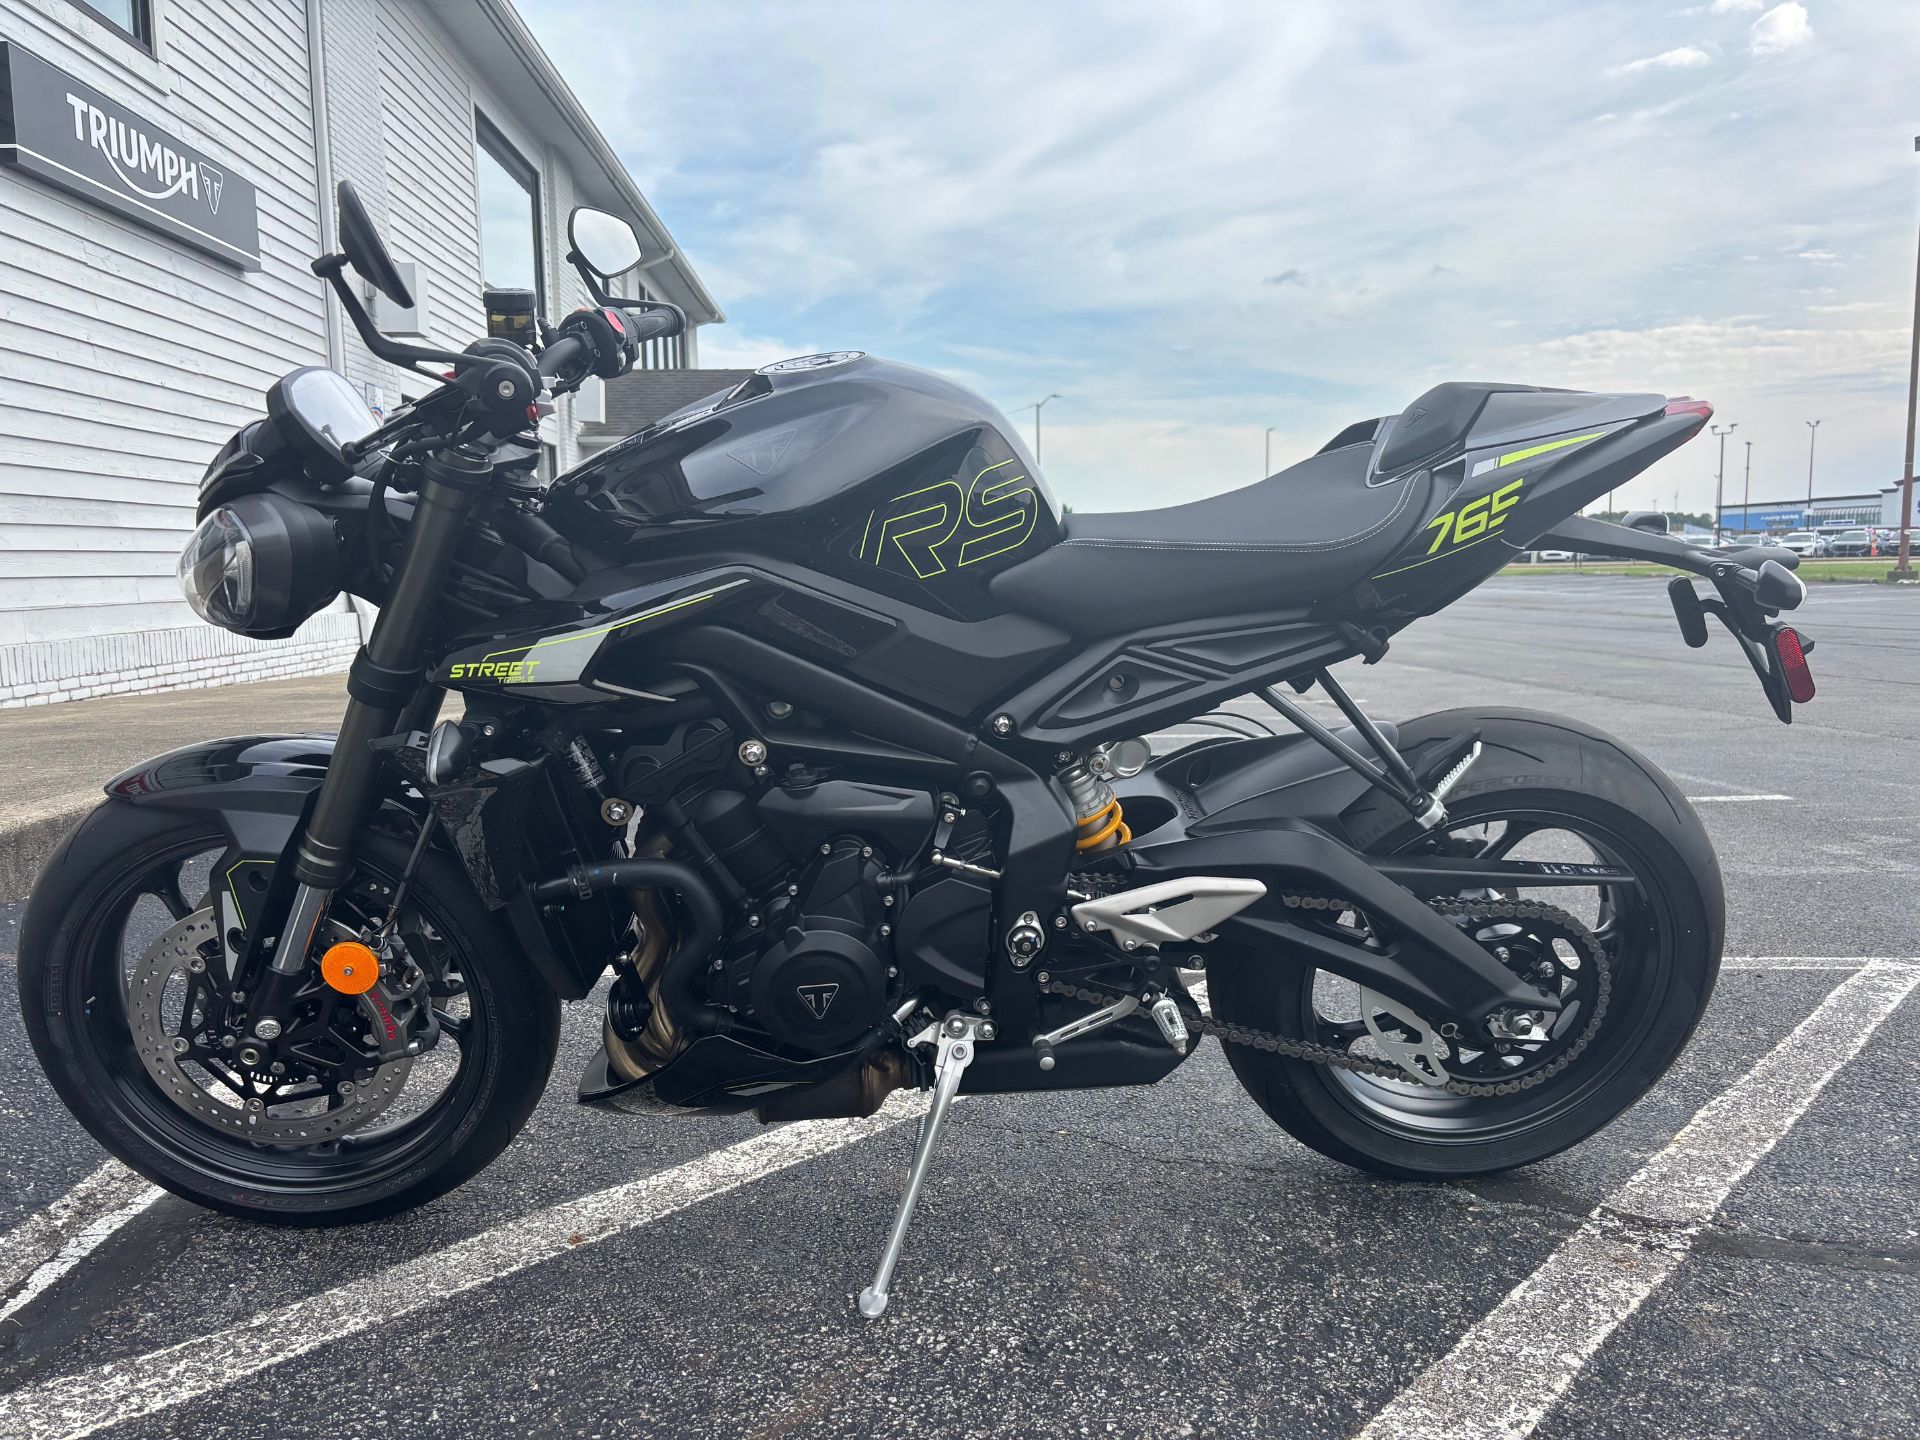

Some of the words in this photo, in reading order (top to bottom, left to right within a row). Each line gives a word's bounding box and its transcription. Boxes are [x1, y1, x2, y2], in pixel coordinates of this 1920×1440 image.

[66, 92, 199, 200] TRIUMPH
[859, 458, 1038, 579] RS
[1426, 478, 1524, 555] 765
[449, 660, 540, 679] STREET
[497, 675, 535, 684] TRIPLE
